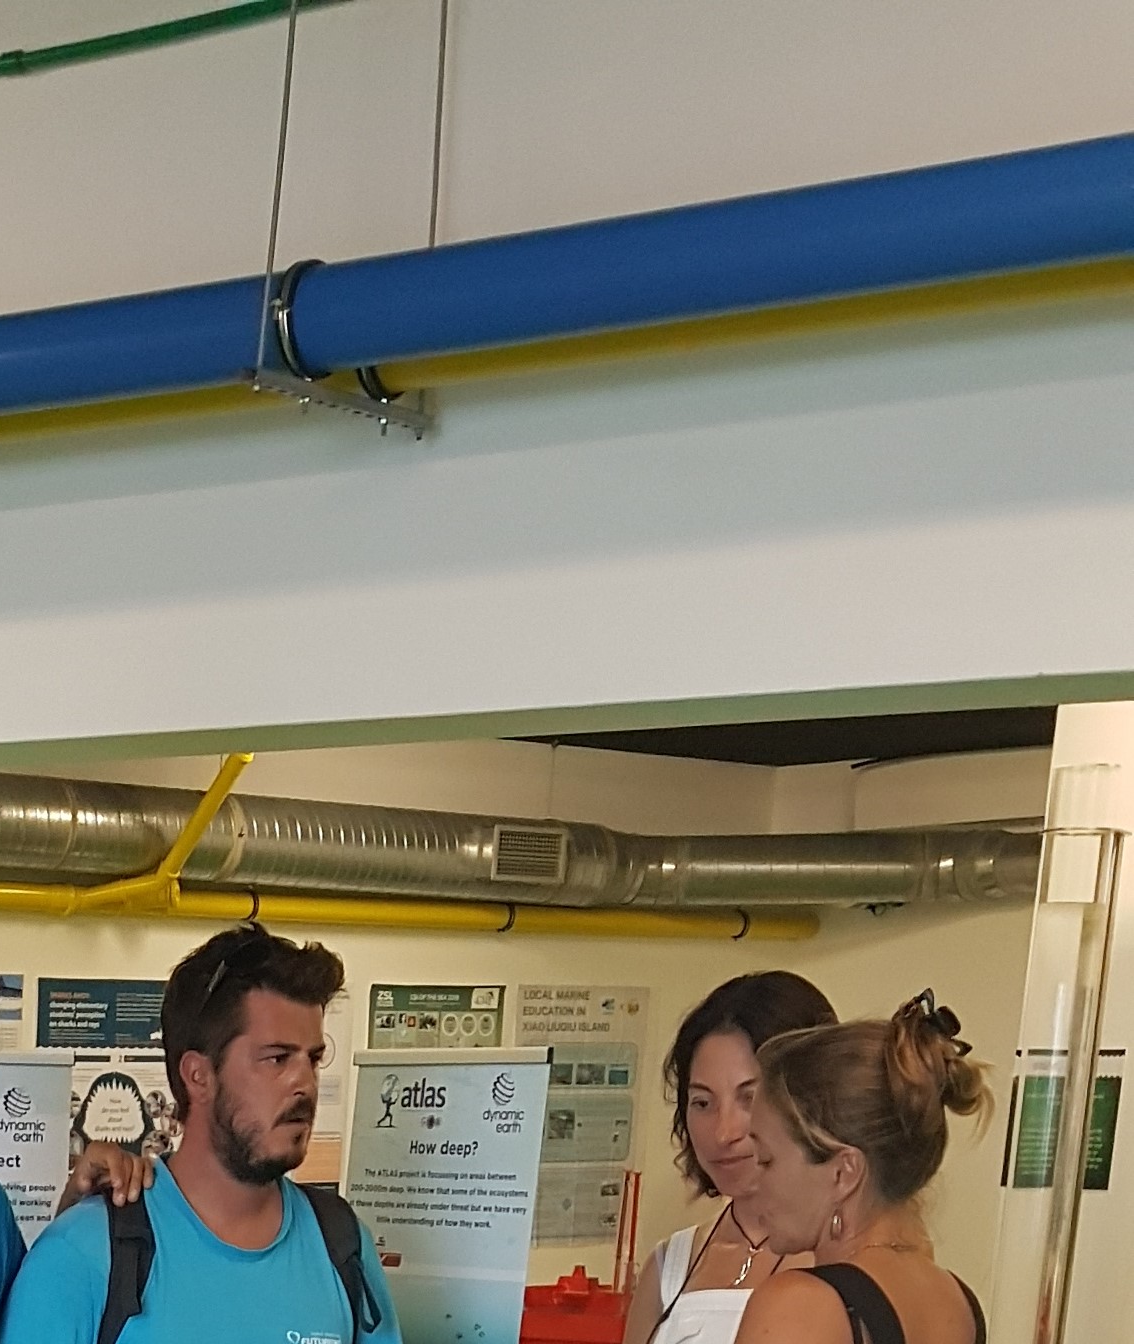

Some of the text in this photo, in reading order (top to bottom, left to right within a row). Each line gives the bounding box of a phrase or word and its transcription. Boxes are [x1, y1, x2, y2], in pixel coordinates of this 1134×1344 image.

[524, 990, 590, 1000] LOCAL MARINE
[522, 1006, 586, 1016] EDUCATION IN
[579, 1022, 610, 1032] ISLAND
[401, 1078, 446, 1108] atlas
[482, 1109, 525, 1122] dynamic
[496, 1122, 522, 1133] earth
[13, 1132, 44, 1143] earth
[410, 1140, 478, 1158] How deep?
[378, 1169, 398, 1178] ATLAS
[488, 1172, 516, 1180] between
[28, 1184, 56, 1192] people
[418, 1186, 434, 1194] know
[20, 1200, 52, 1208] working
[494, 1205, 510, 1213] have
[512, 1208, 527, 1216] very
[36, 1214, 52, 1222] and
[445, 1218, 458, 1226] how
